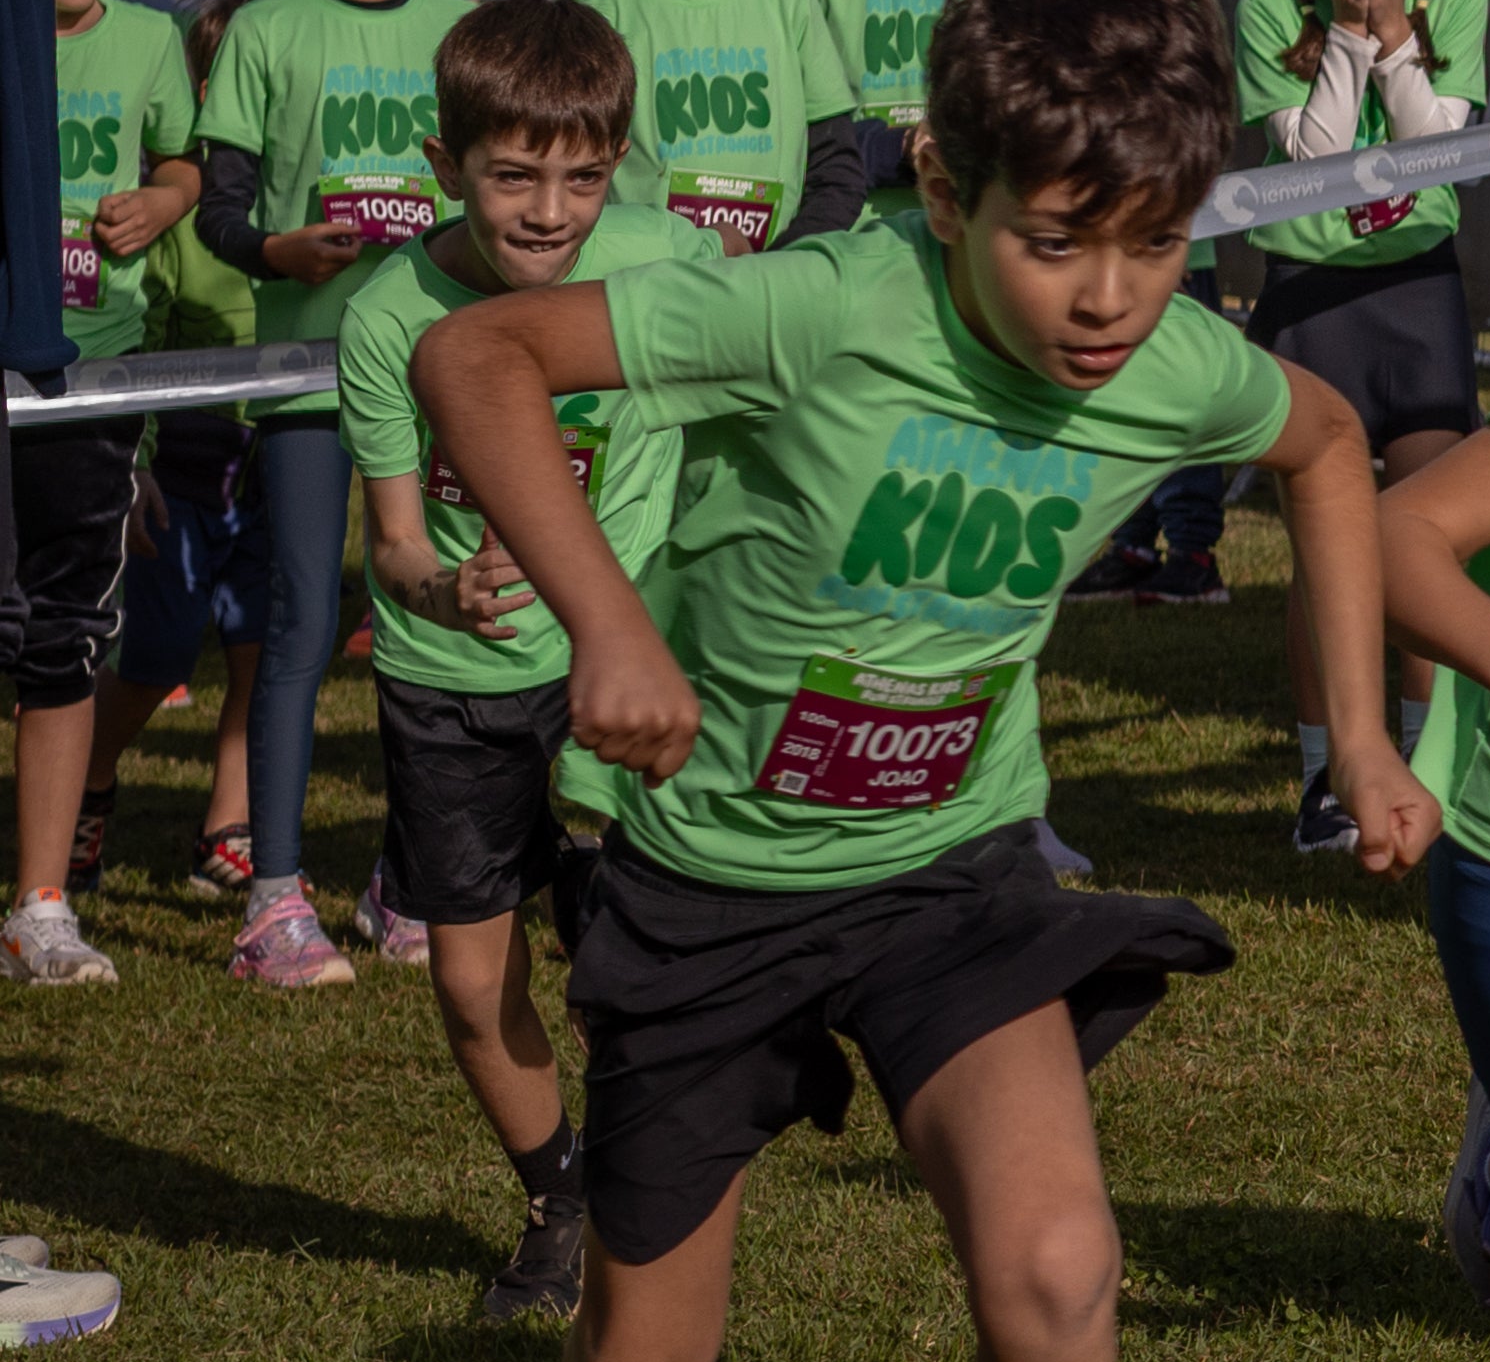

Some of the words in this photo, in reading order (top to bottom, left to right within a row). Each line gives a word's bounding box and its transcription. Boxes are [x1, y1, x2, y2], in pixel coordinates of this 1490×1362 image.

[655, 46, 768, 78] ATHENAS
[656, 71, 771, 144] KIDS
[322, 91, 441, 160] KIDS
[657, 140, 693, 160] RUN
[696, 135, 773, 156] STRONGER
[357, 197, 433, 228] 10056
[701, 205, 768, 239] 10057
[886, 414, 1099, 504] ATHENAS
[841, 470, 1082, 600] KIDS
[779, 740, 822, 761] 2018
[846, 716, 979, 763] 10073
[867, 768, 929, 787] JOAO
